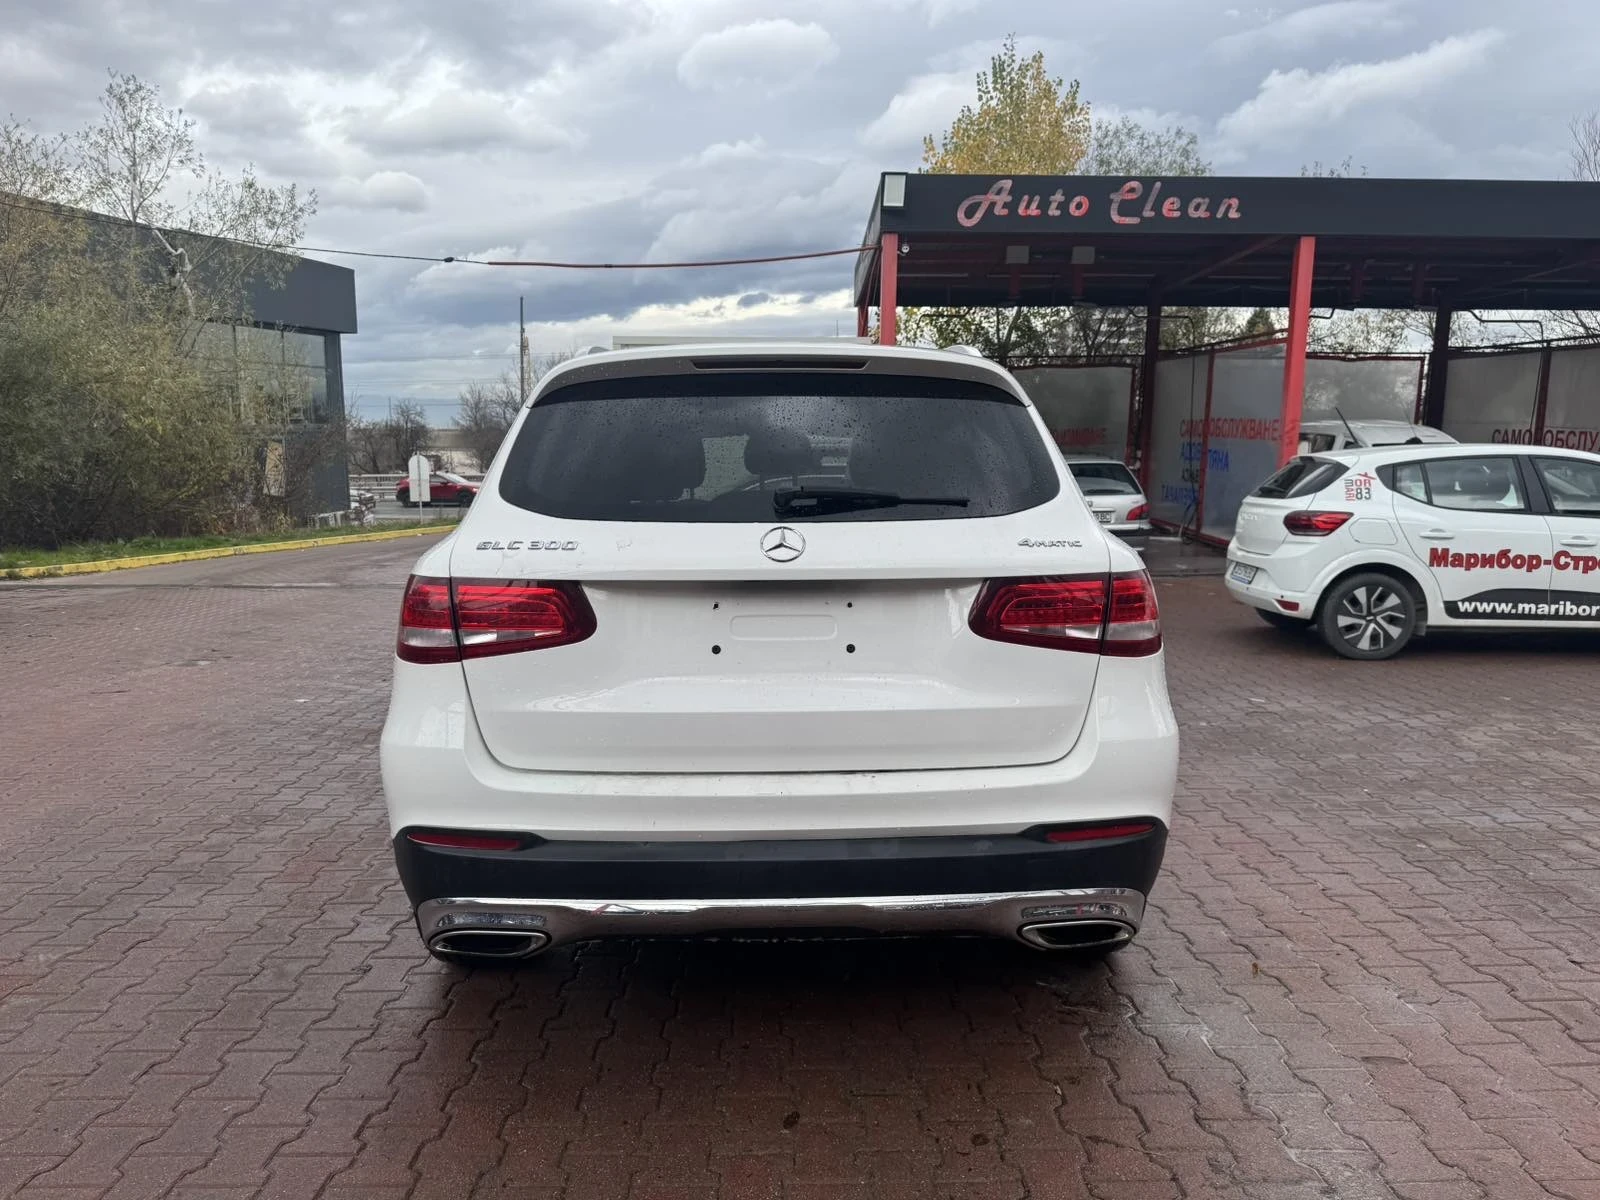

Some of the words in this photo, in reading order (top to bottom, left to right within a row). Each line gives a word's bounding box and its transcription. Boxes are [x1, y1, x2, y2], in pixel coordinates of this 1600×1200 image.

[957, 179, 1090, 227] Auto
[1109, 180, 1241, 224] Clean
[1355, 487, 1371, 500] 83
[476, 540, 523, 551] GLC
[528, 540, 579, 551] 300
[1018, 537, 1082, 548] 4MATIC
[1429, 548, 1600, 574] Марибор-Стр
